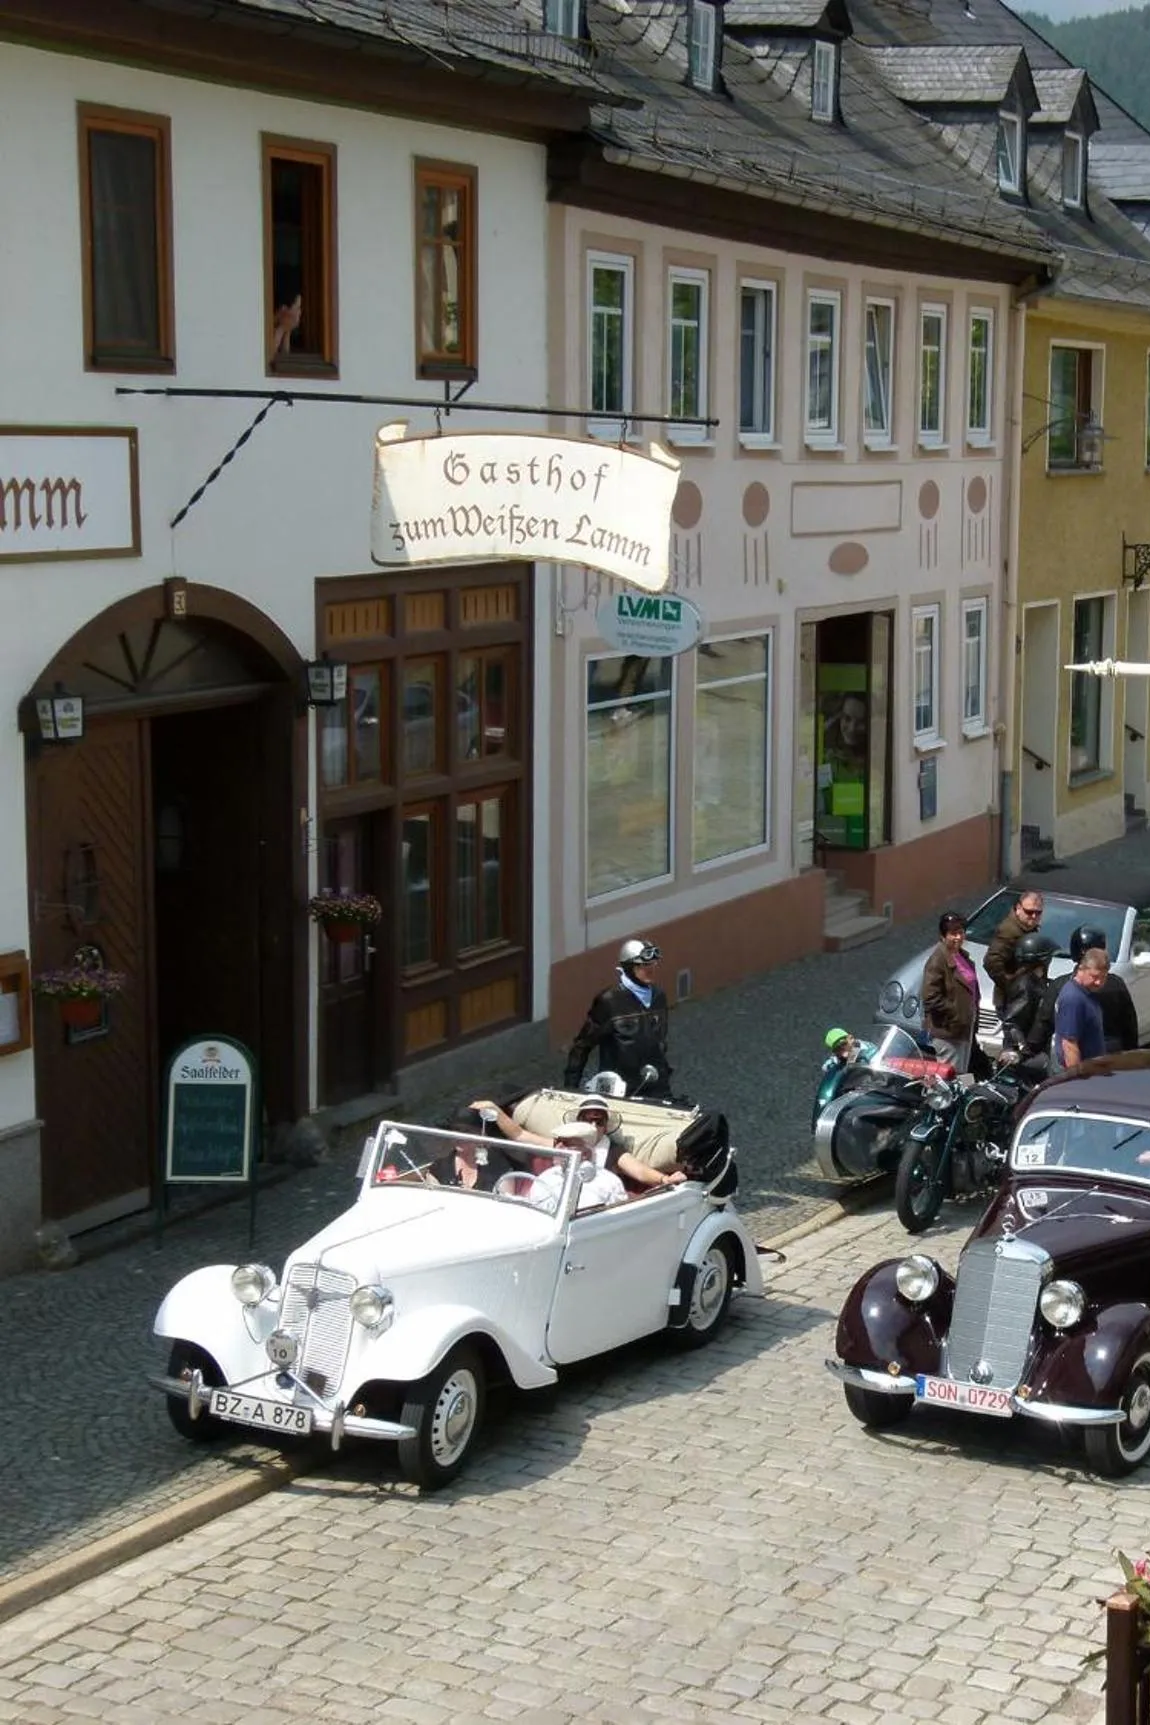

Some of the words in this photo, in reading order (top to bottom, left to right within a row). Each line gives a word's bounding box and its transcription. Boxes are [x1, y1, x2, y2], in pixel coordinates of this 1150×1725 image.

[443, 450, 609, 502] Gasthof
[389, 517, 447, 551] zum
[565, 514, 652, 566] Lamm
[618, 595, 660, 620] LVM
[181, 1066, 240, 1079] Saalfelder
[927, 1381, 958, 1401] SON
[273, 1406, 306, 1429] 878
